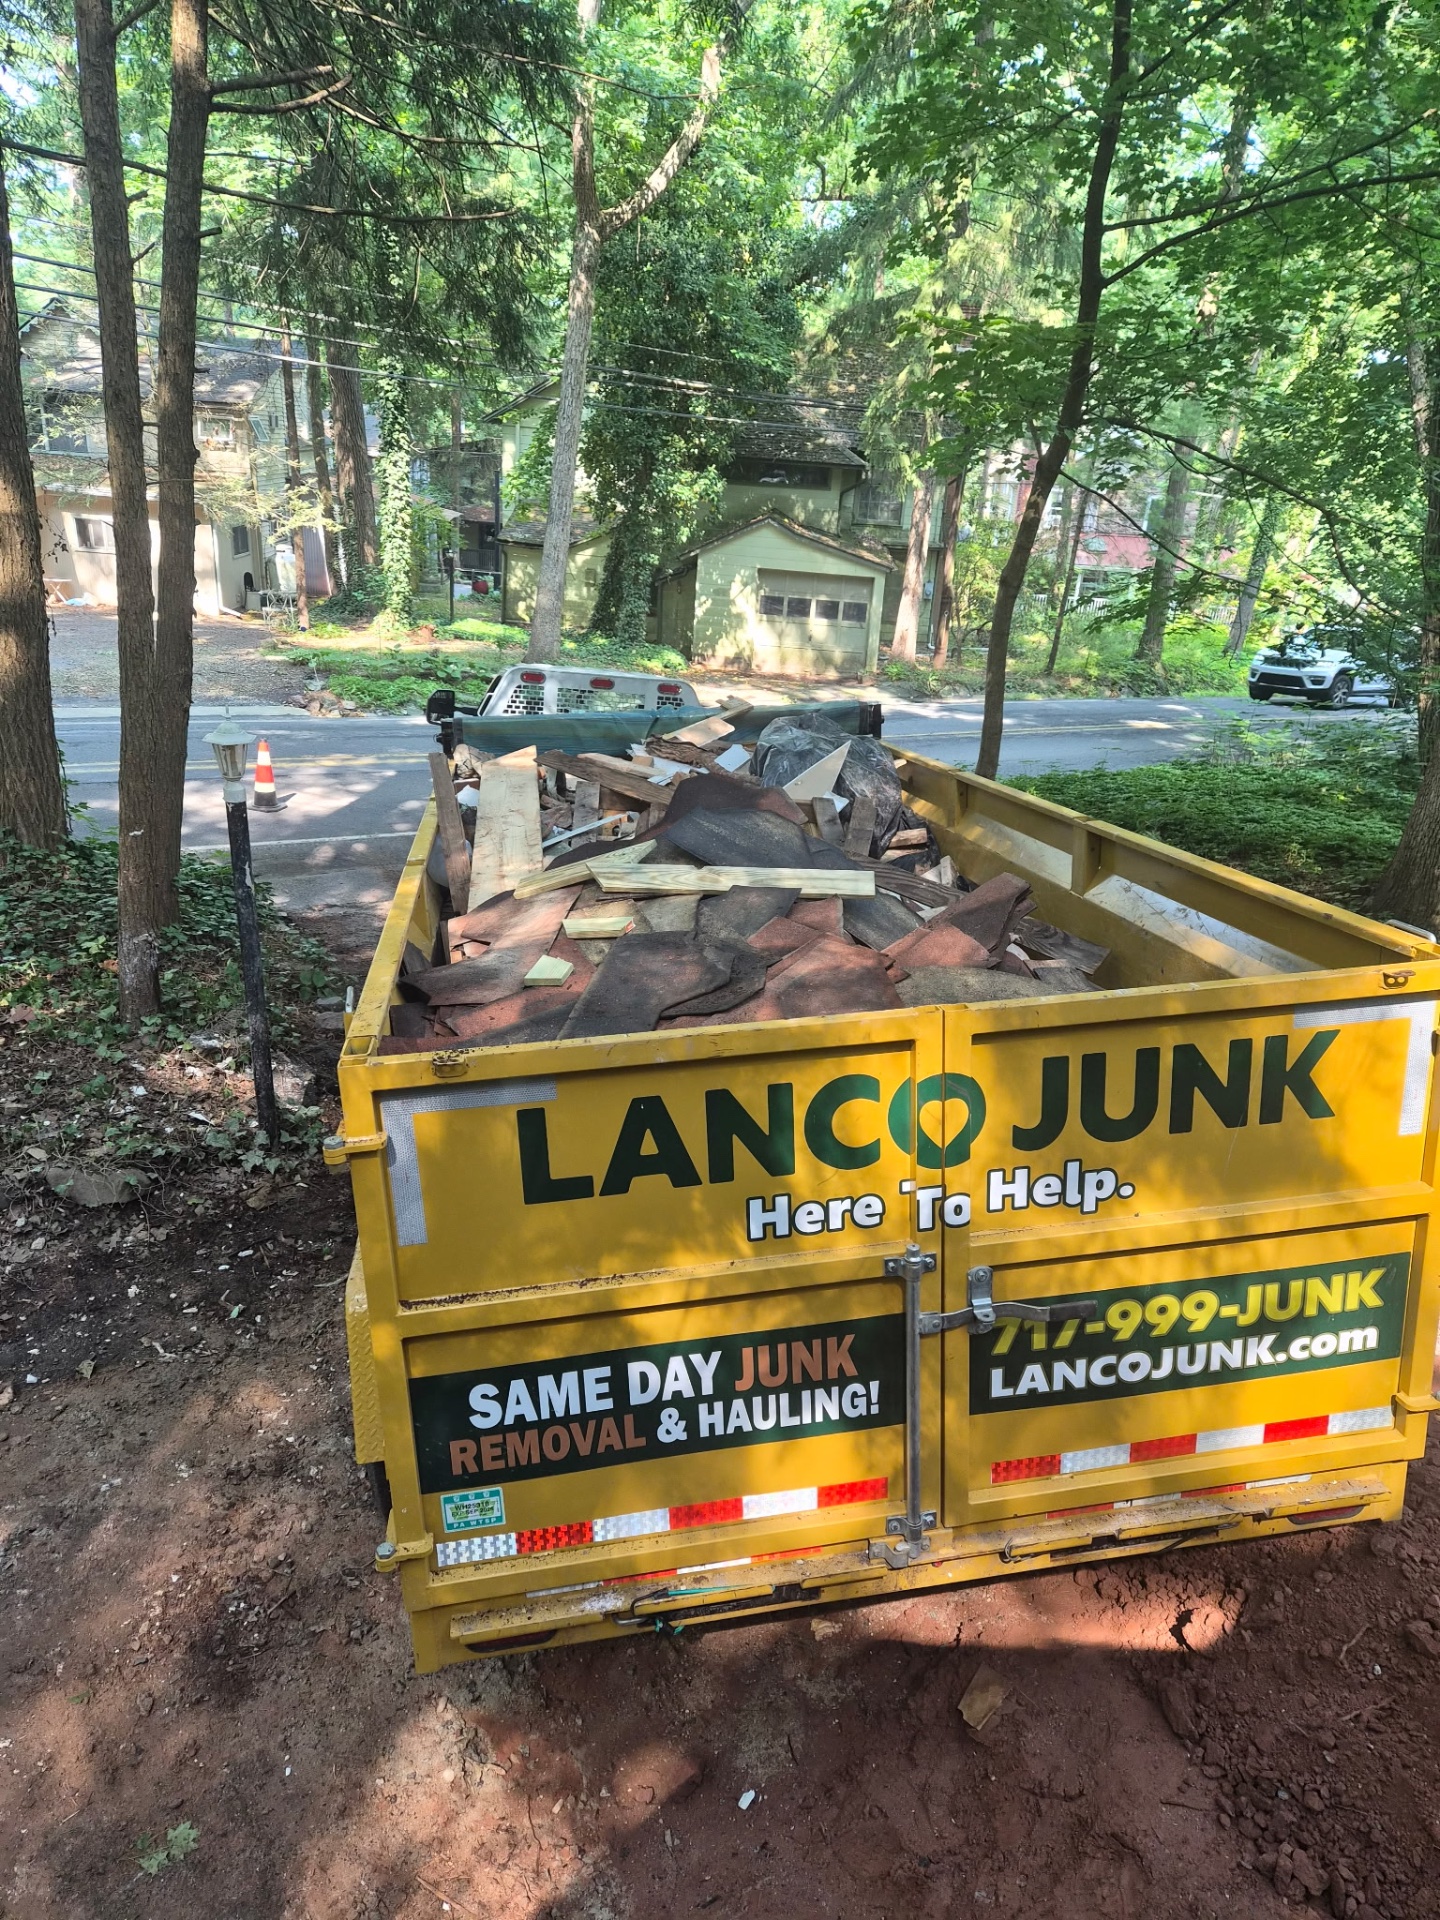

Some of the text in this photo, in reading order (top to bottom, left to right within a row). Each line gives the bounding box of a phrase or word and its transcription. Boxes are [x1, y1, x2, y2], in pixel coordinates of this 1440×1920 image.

[516, 1029, 1341, 1205] LANCO JUNK
[746, 1158, 1136, 1242] Here To Help.
[990, 1268, 1385, 1355] 717-999-JUNK
[468, 1333, 859, 1430] SAME DAY JUNK
[990, 1326, 1379, 1398] LANCOJUNK.com
[449, 1379, 881, 1476] REMOVAL & HAULING!
